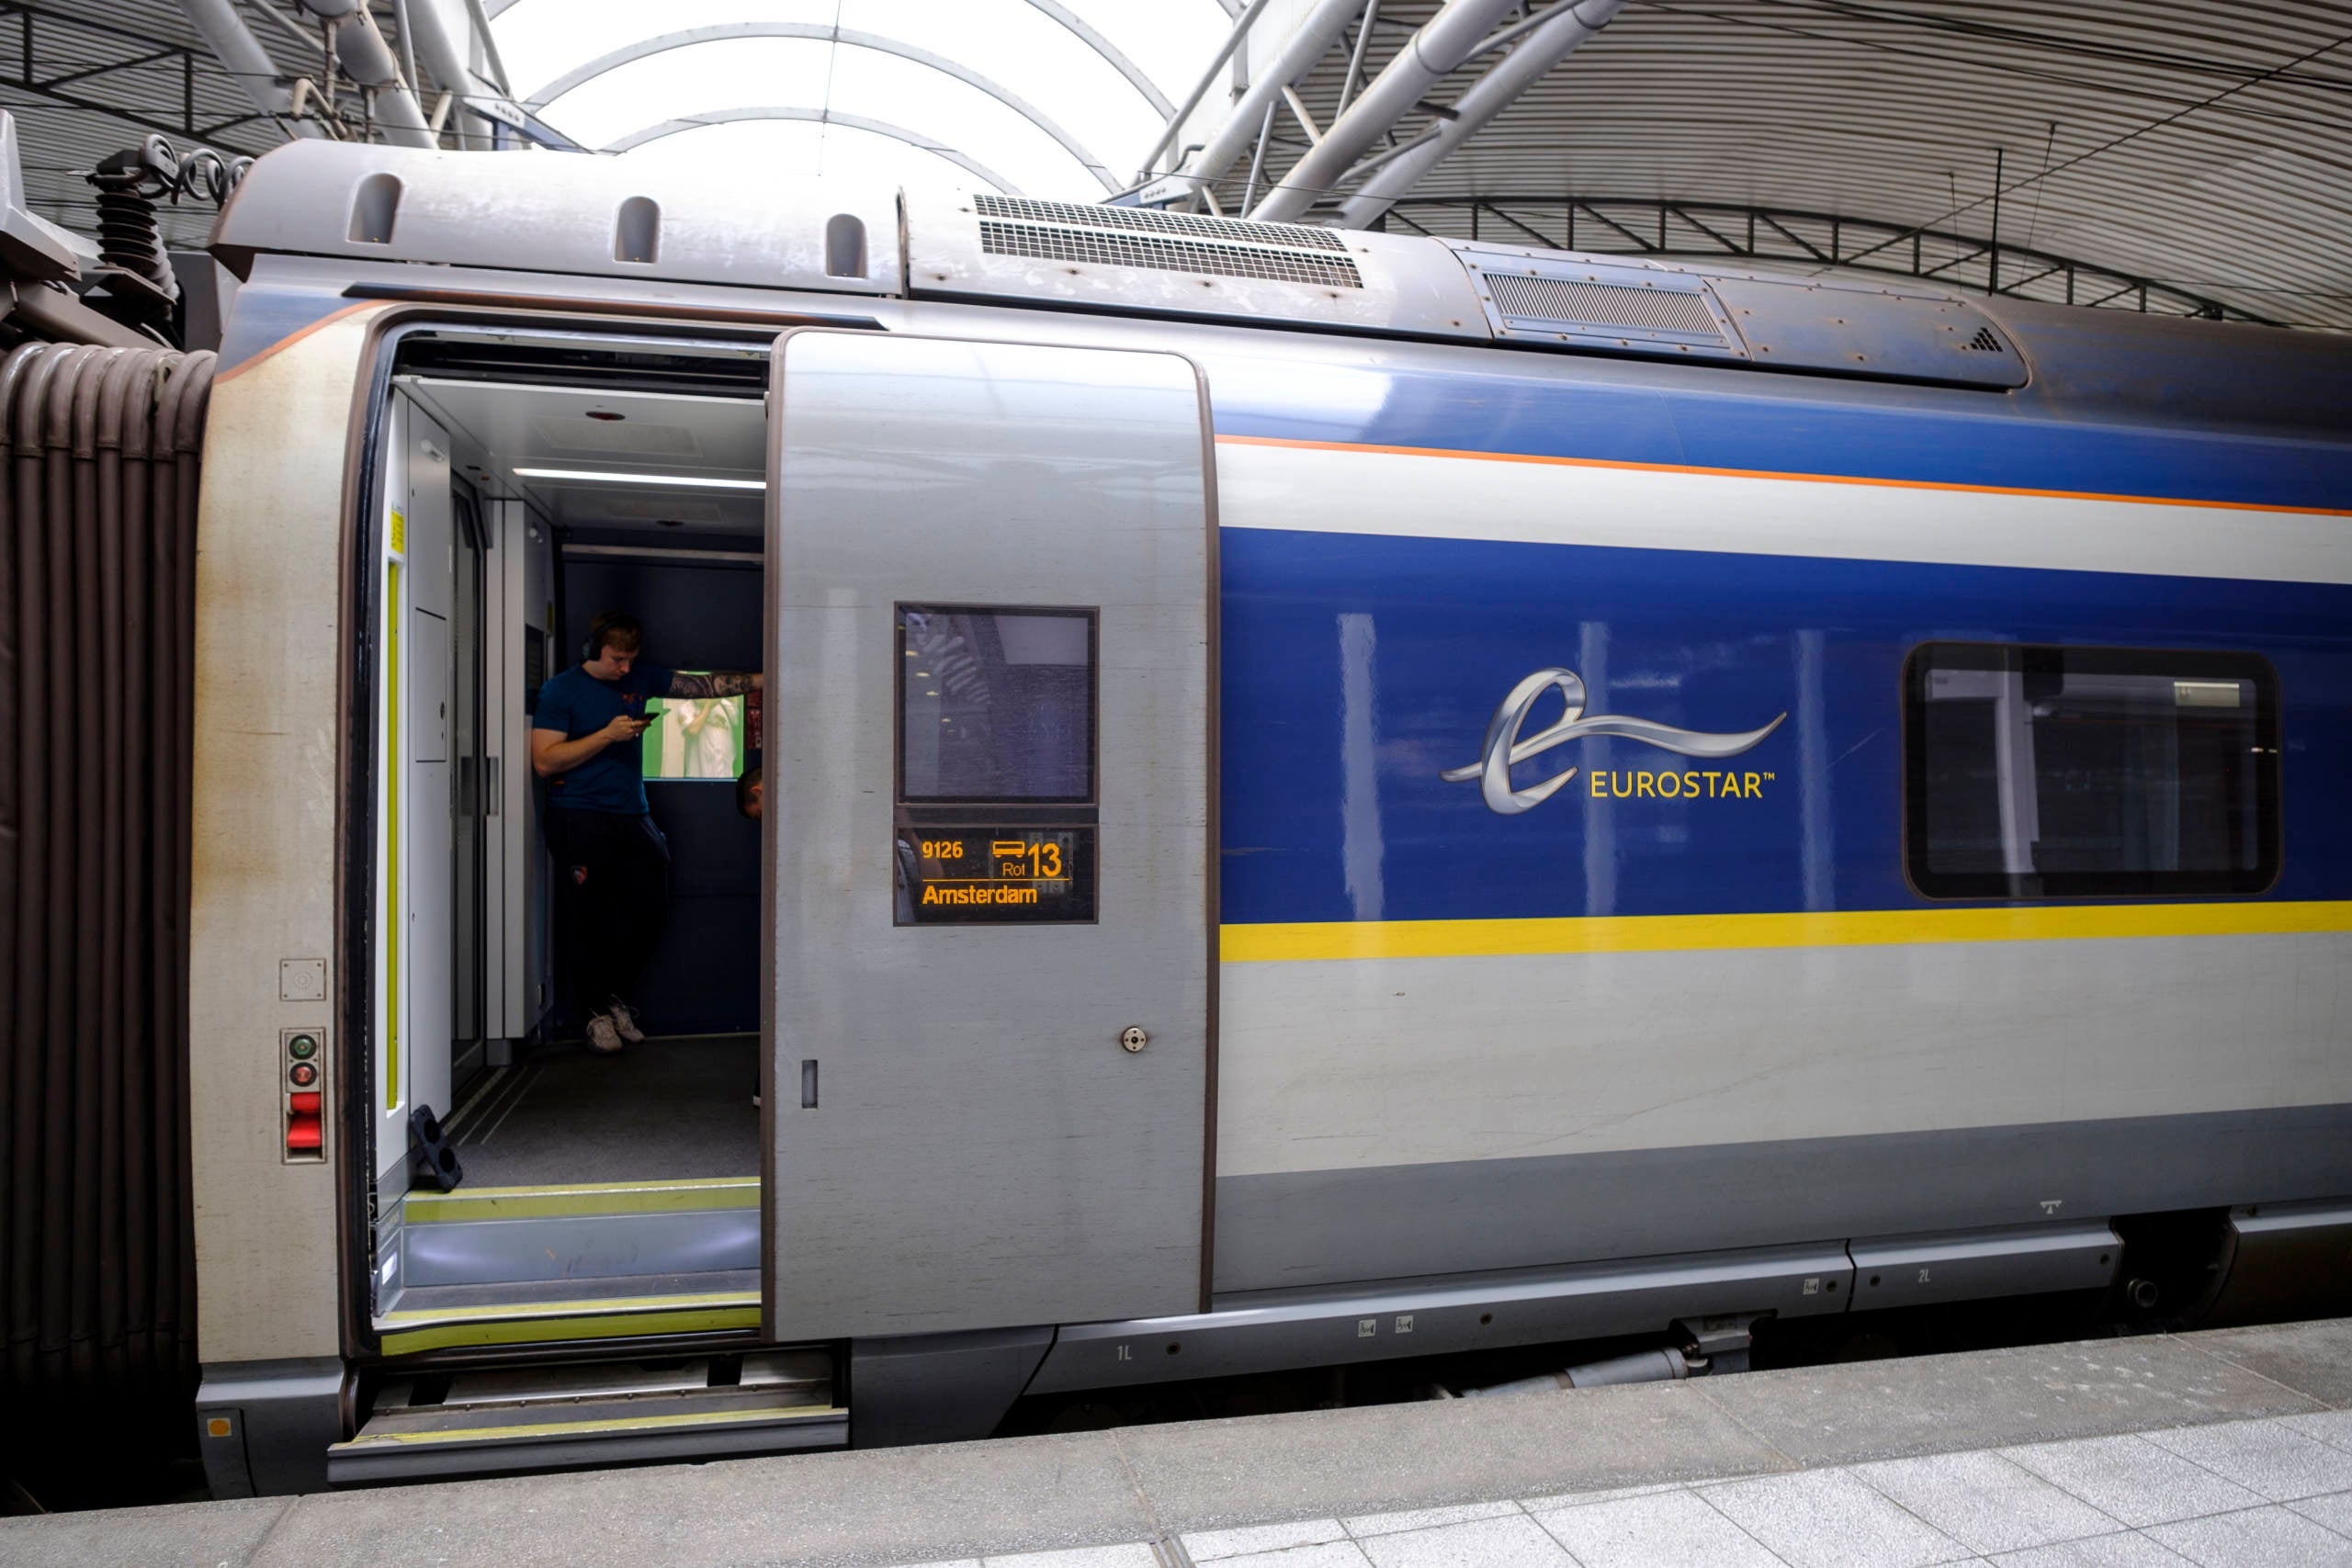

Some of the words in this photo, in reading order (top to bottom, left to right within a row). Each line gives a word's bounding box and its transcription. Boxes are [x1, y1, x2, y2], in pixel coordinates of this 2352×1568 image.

[922, 840, 964, 859] 9126
[1027, 842, 1063, 877] 13
[922, 885, 1038, 905] Amsterdam
